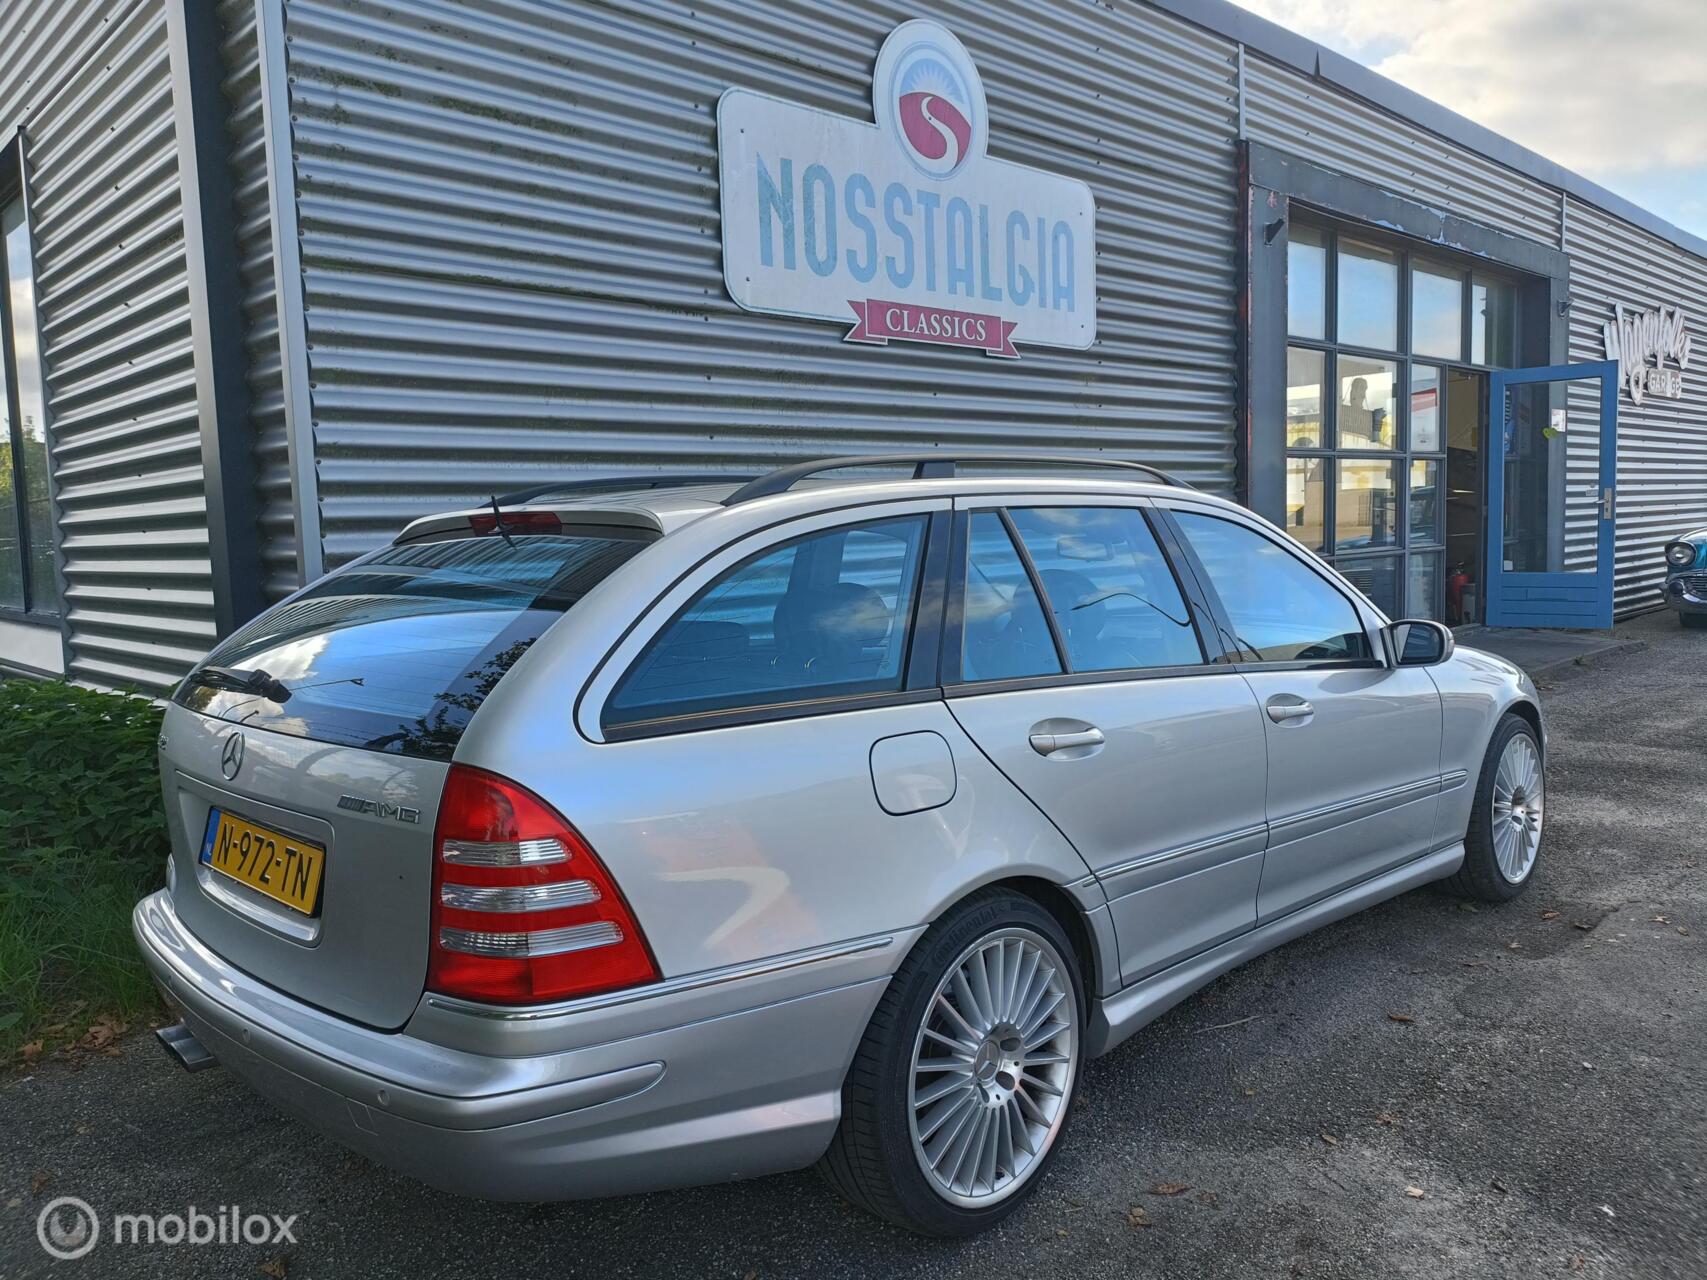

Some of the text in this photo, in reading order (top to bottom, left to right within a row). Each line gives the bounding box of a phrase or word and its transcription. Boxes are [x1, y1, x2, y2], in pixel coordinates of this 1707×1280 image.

[756, 151, 1075, 312] NOSSTALGIA
[886, 308, 986, 341] CLASSICS
[1650, 373, 1680, 395] GARGE
[362, 799, 420, 824] AMG
[218, 821, 313, 901] N-972-TN
